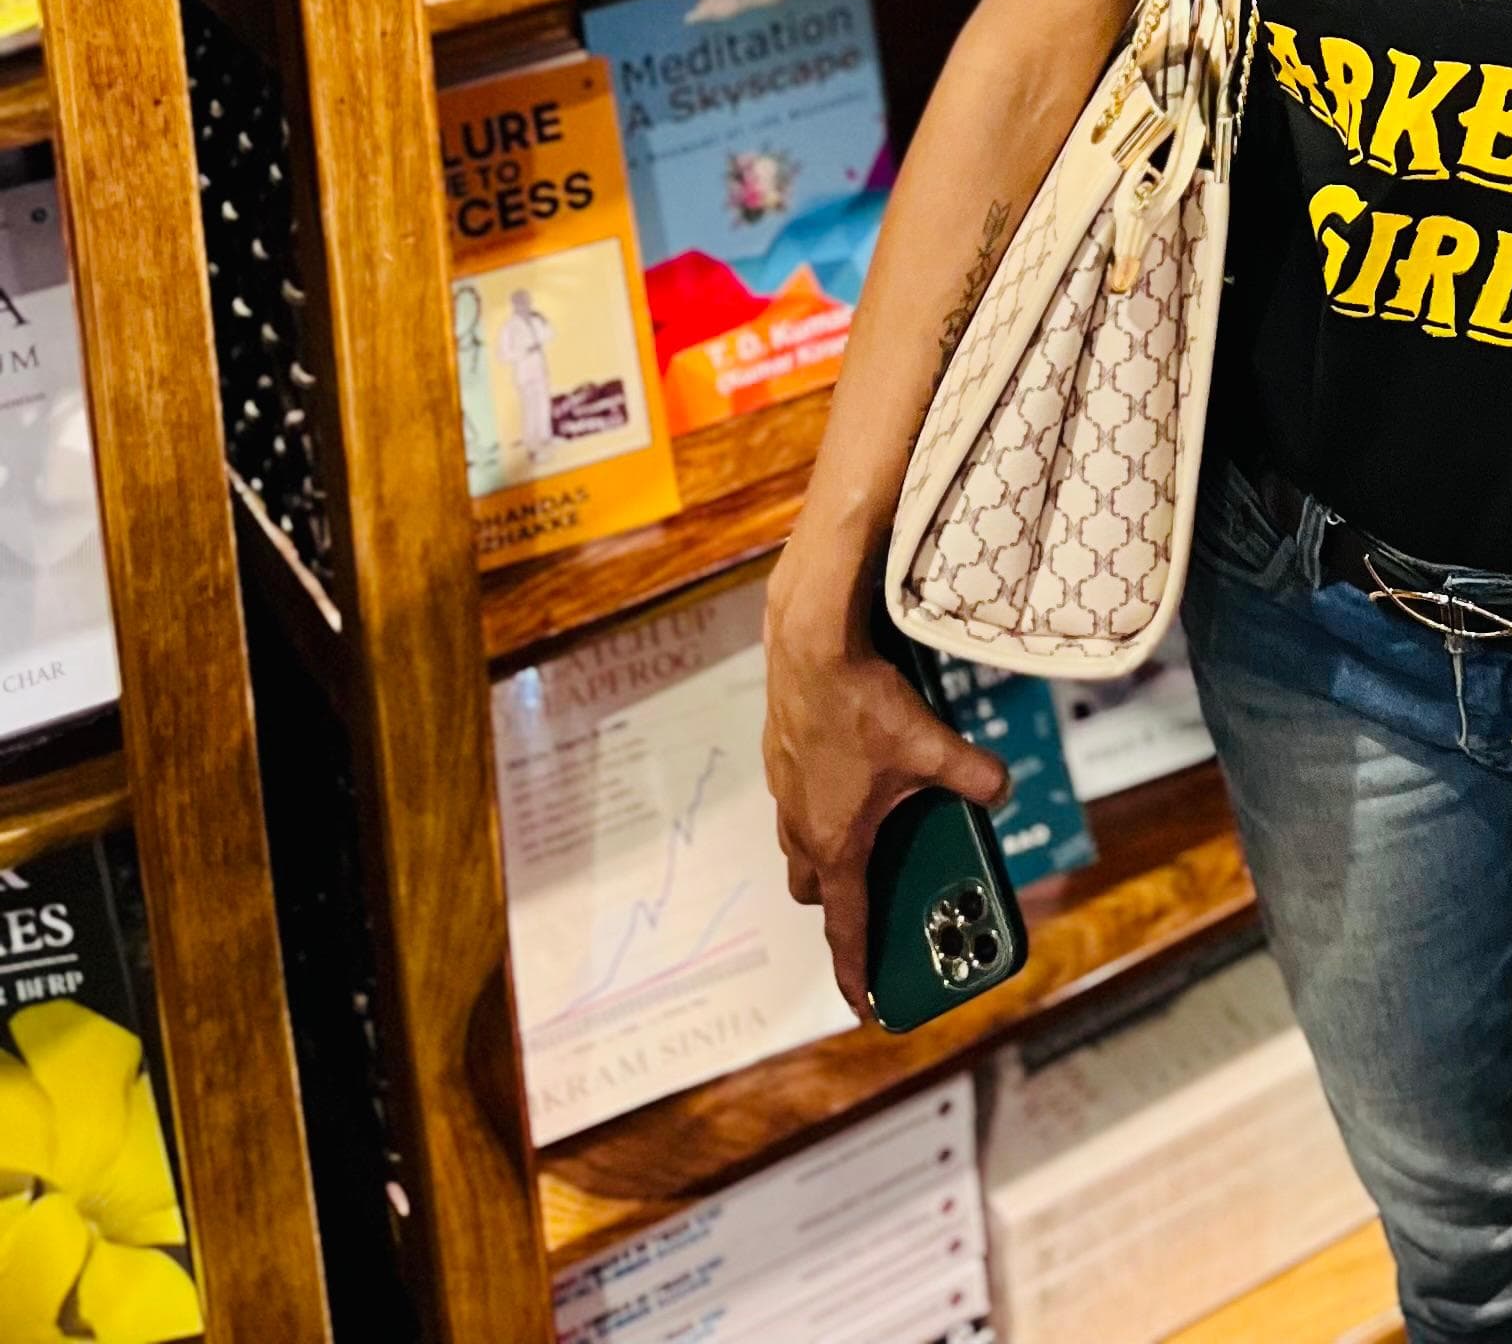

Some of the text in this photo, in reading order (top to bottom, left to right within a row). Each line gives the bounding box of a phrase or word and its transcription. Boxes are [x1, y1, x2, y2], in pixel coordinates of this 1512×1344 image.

[621, 4, 854, 95] Meditation
[625, 102, 654, 139] A
[668, 44, 862, 124] Skyscape
[454, 171, 594, 239] CESS
[477, 161, 522, 191] TO
[2, 659, 69, 696] CHAR
[0, 903, 75, 957] ES
